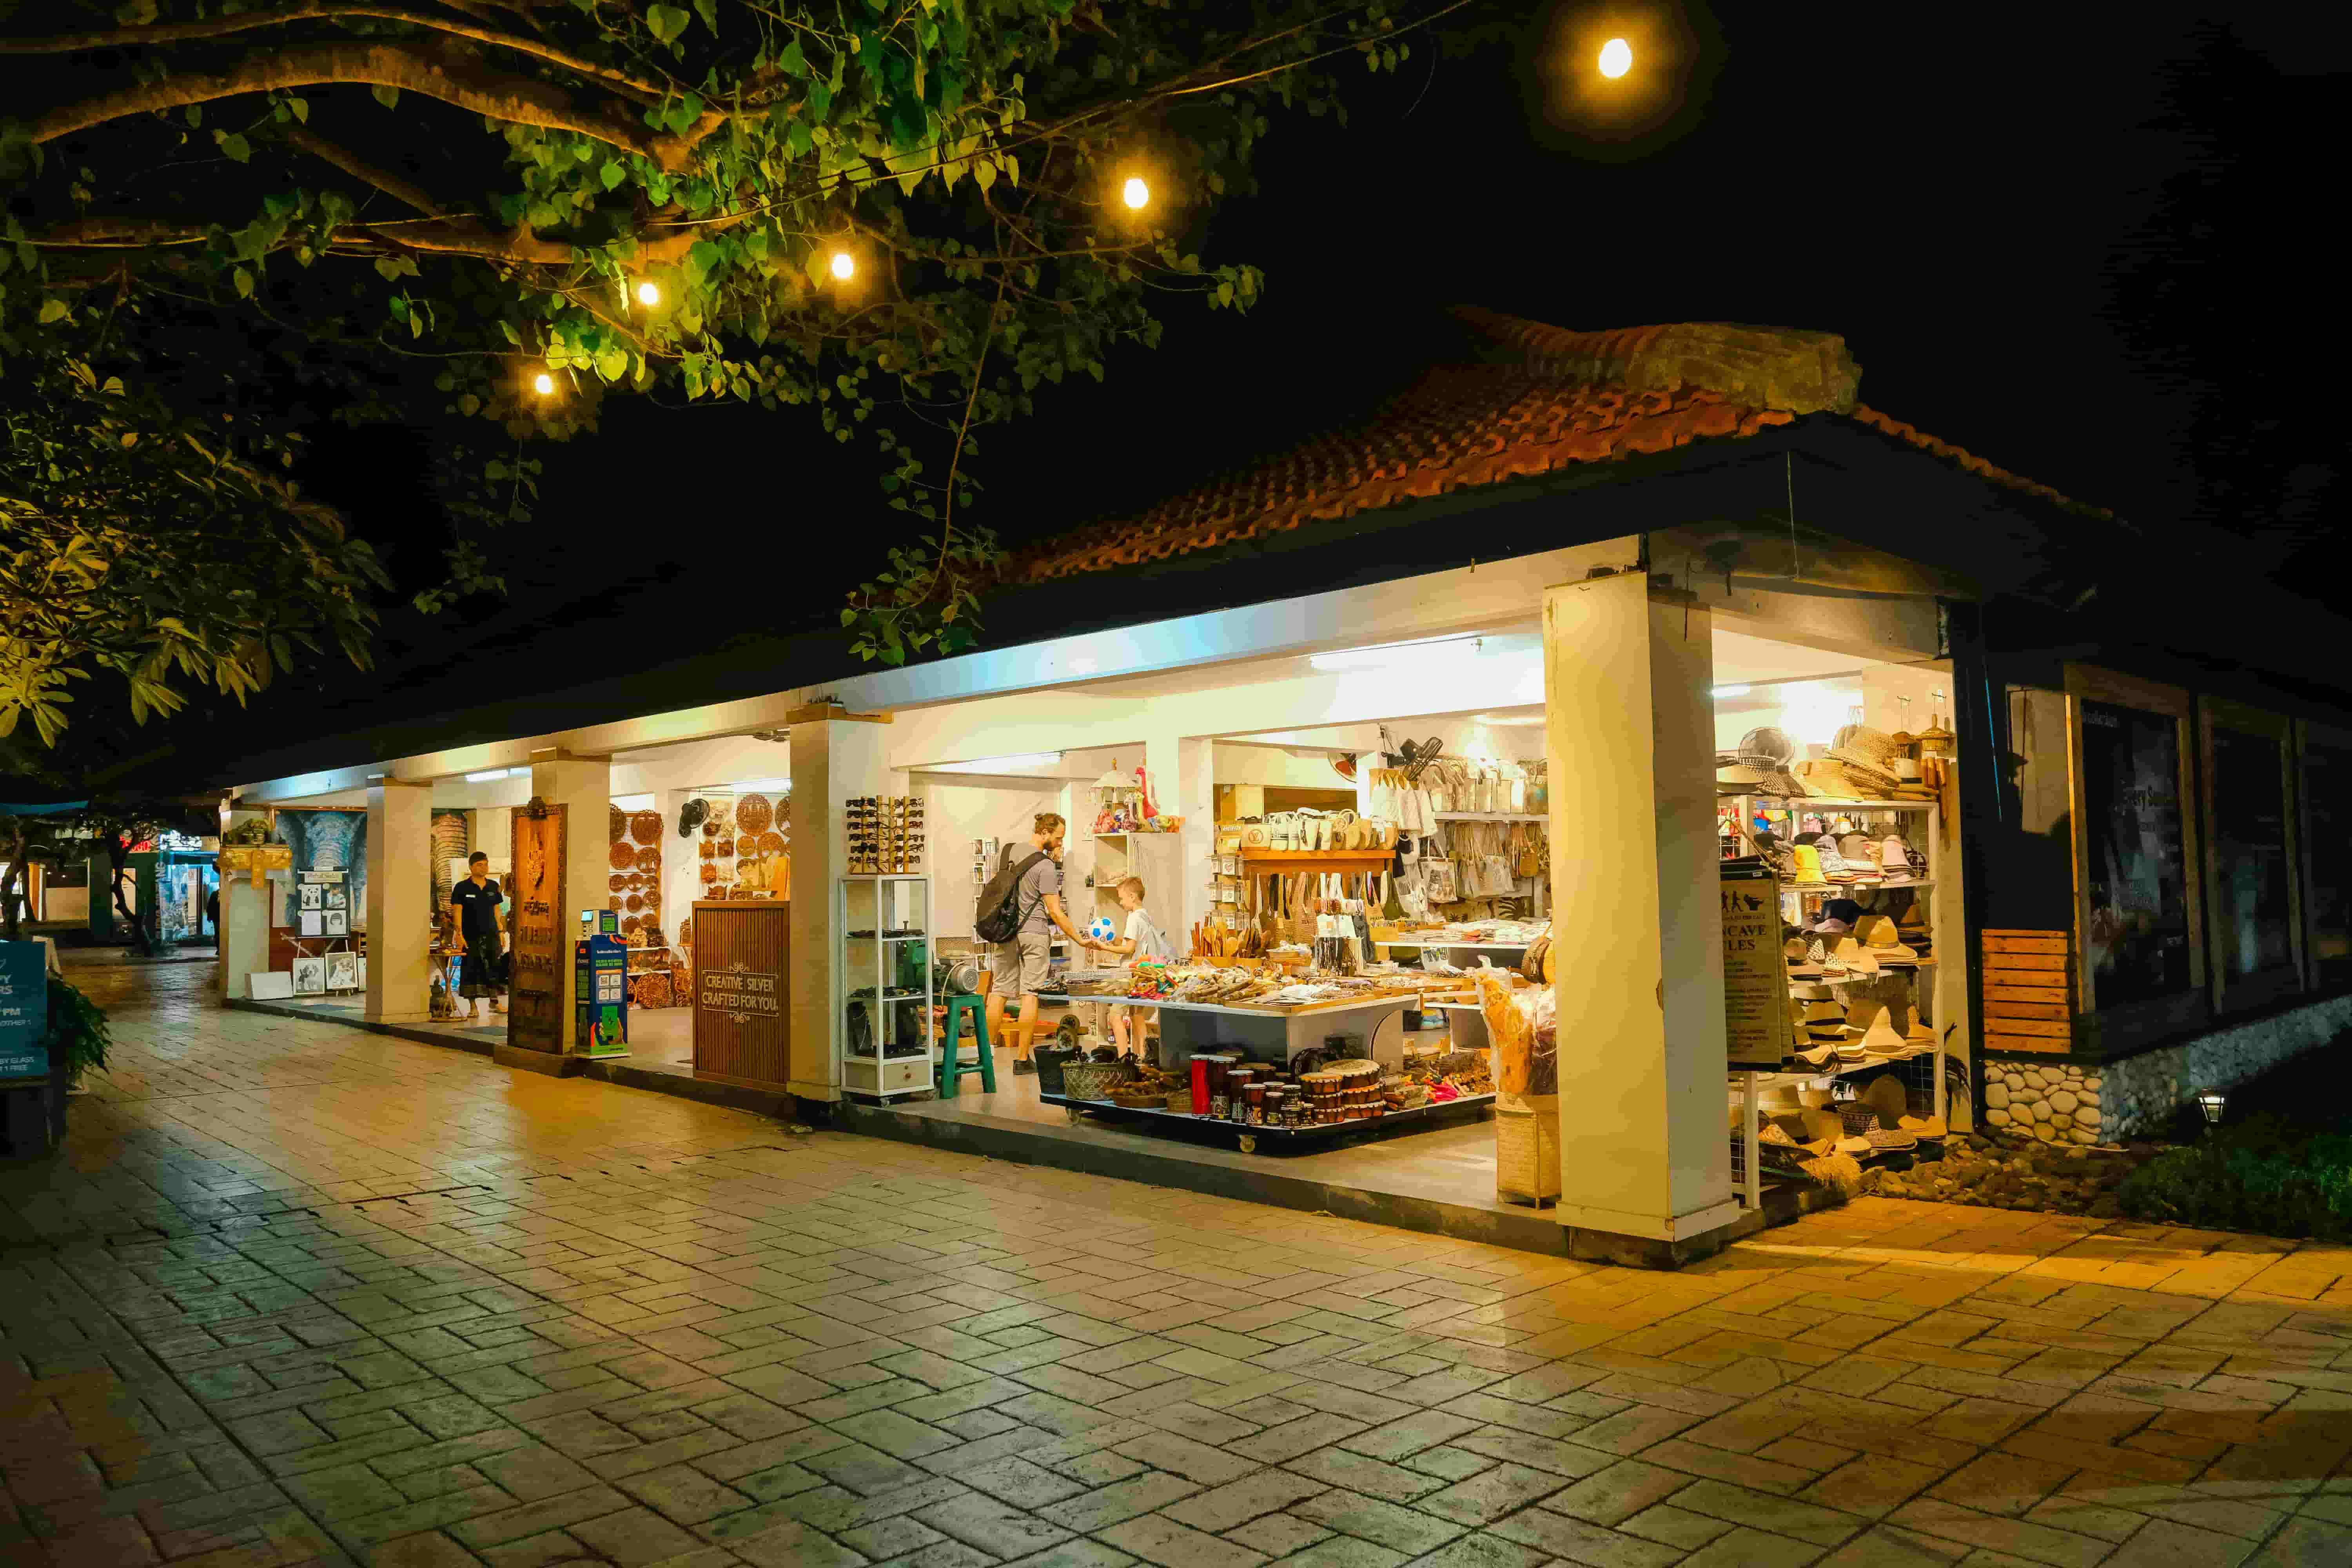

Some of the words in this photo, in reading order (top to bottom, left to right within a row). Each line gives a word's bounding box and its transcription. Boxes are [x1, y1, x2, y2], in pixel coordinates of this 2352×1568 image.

[1723, 939, 1755, 951] LES
[706, 975, 743, 990] CREATIVE
[747, 978, 774, 993] SILVER
[702, 992, 739, 1007] CRAFTED
[740, 995, 757, 1009] FOR
